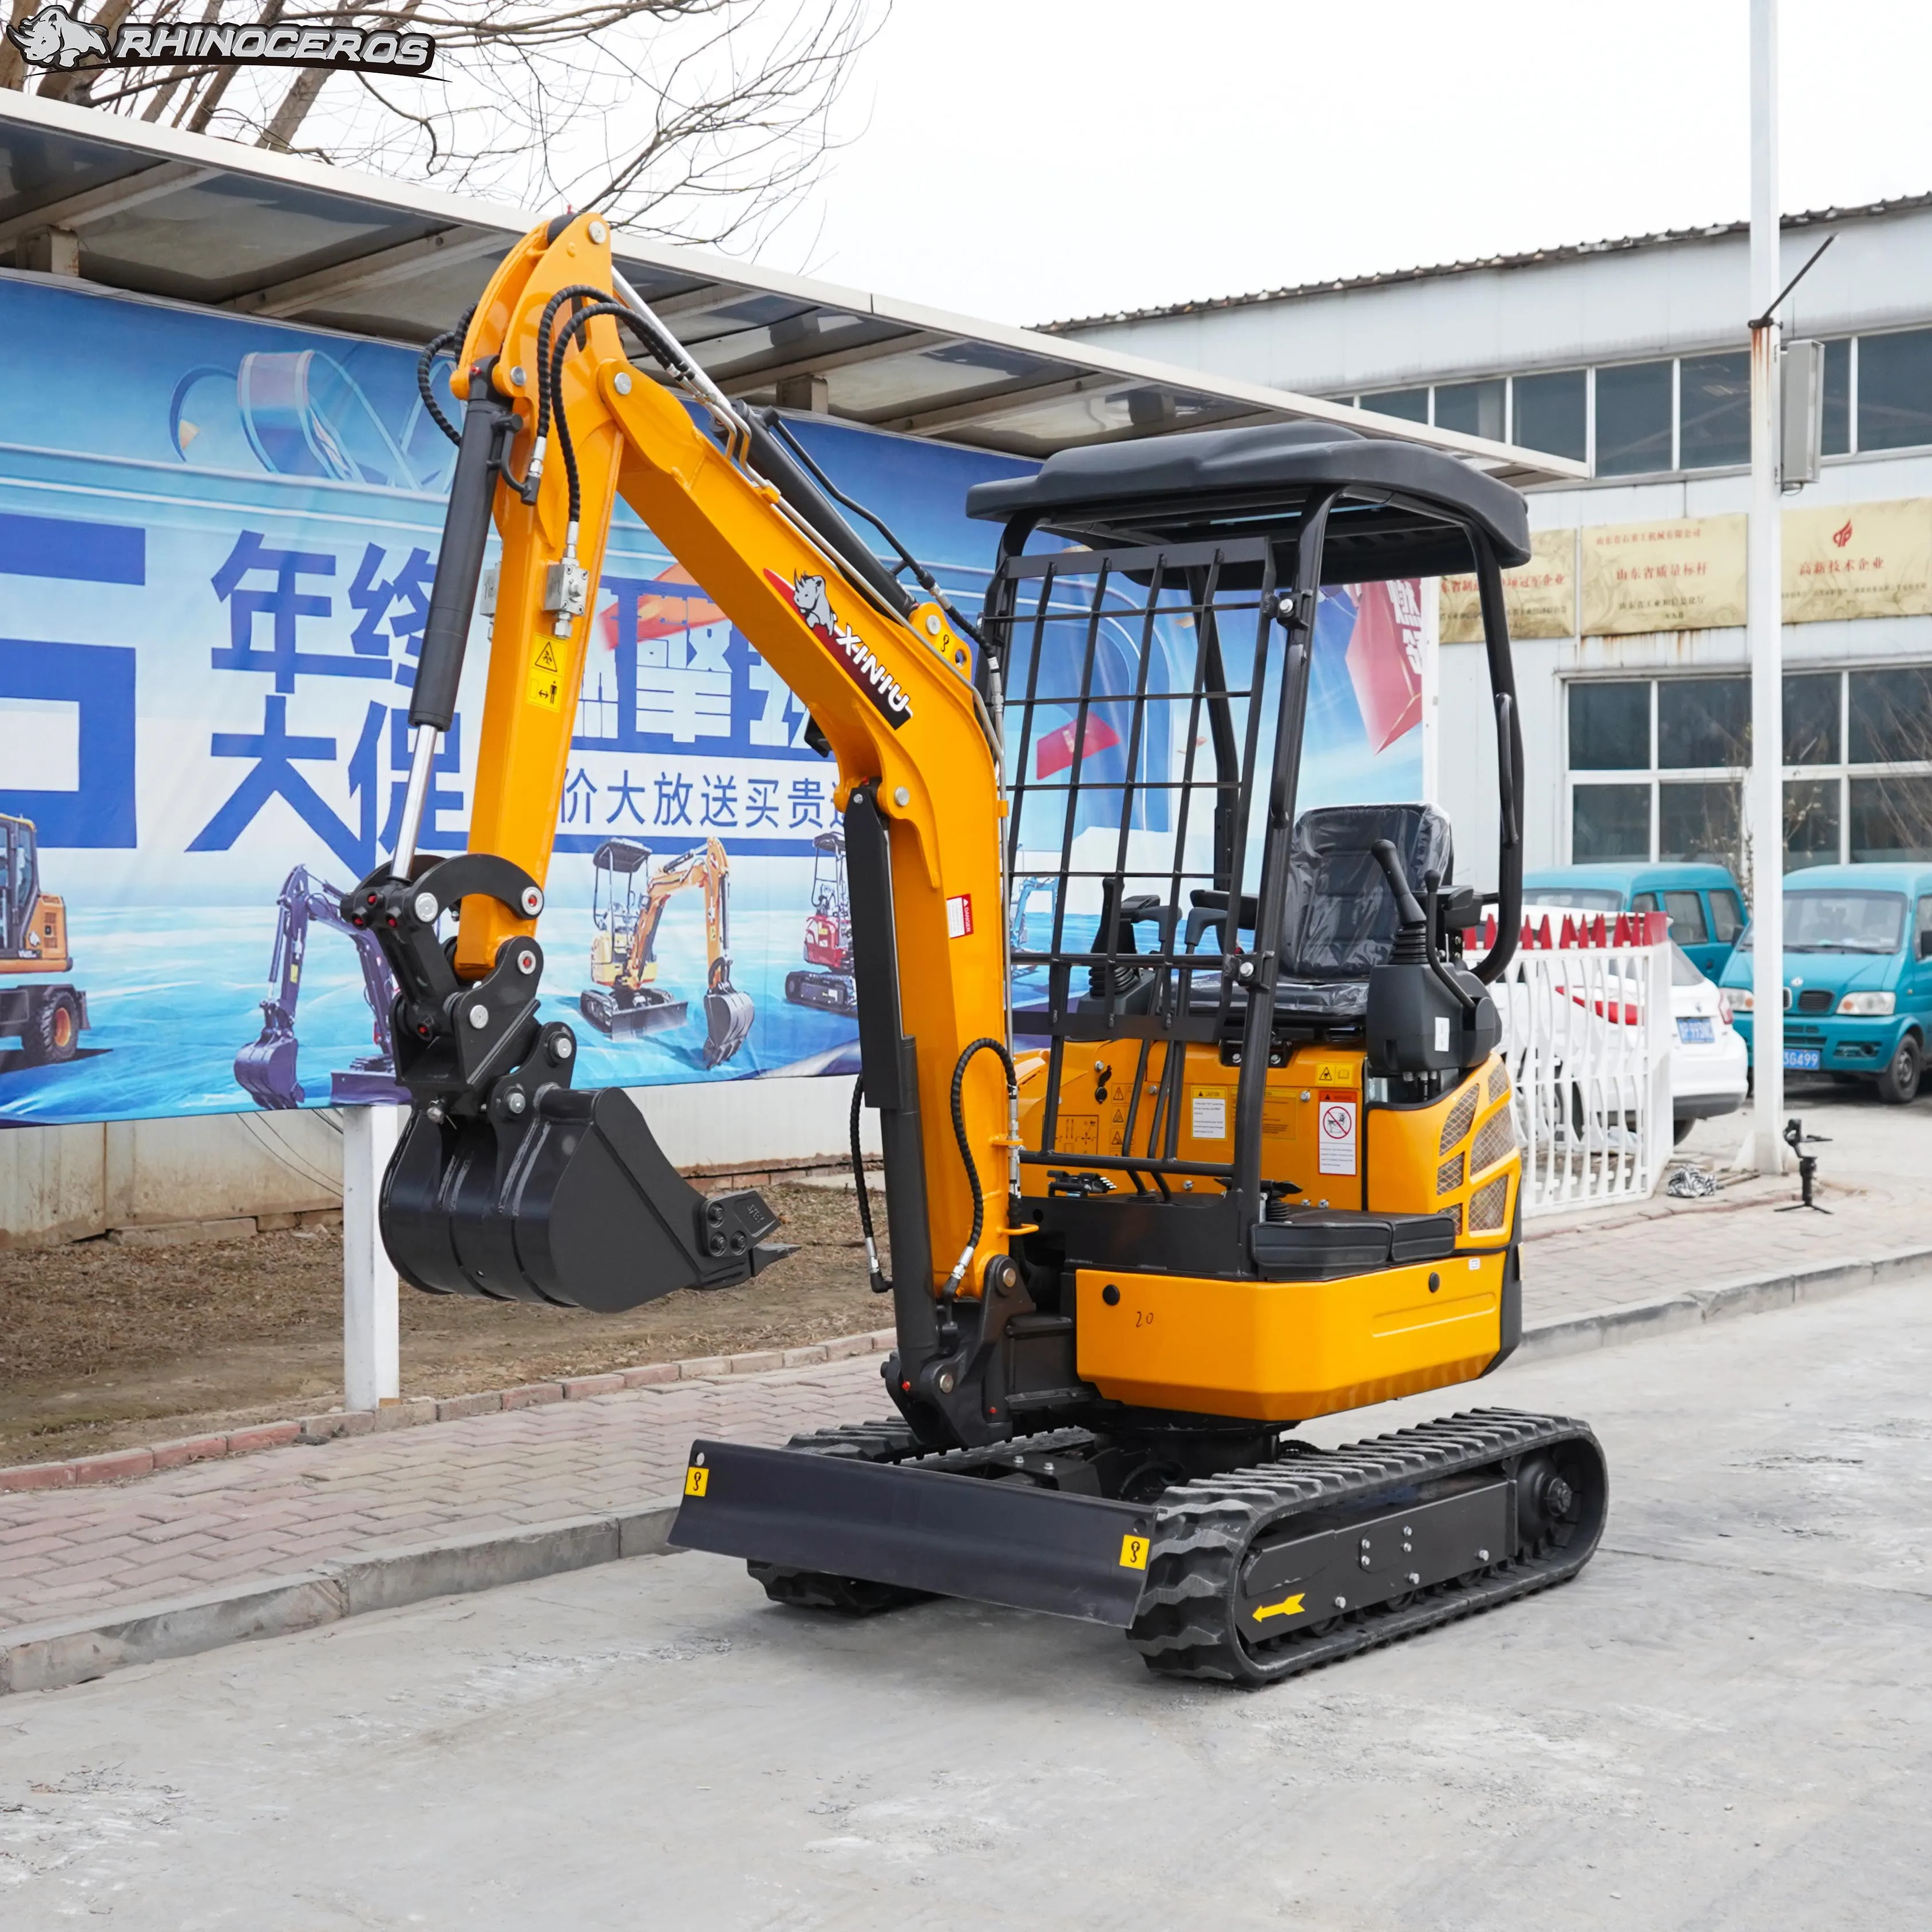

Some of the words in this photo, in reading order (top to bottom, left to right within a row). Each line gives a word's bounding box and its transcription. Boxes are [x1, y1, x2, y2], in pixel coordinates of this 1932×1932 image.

[1616, 560, 1708, 581] 山东省质量标杆
[1799, 556, 1885, 576] 高新技术企业
[835, 623, 911, 712] XINIU
[1135, 1311, 1154, 1328] 20
